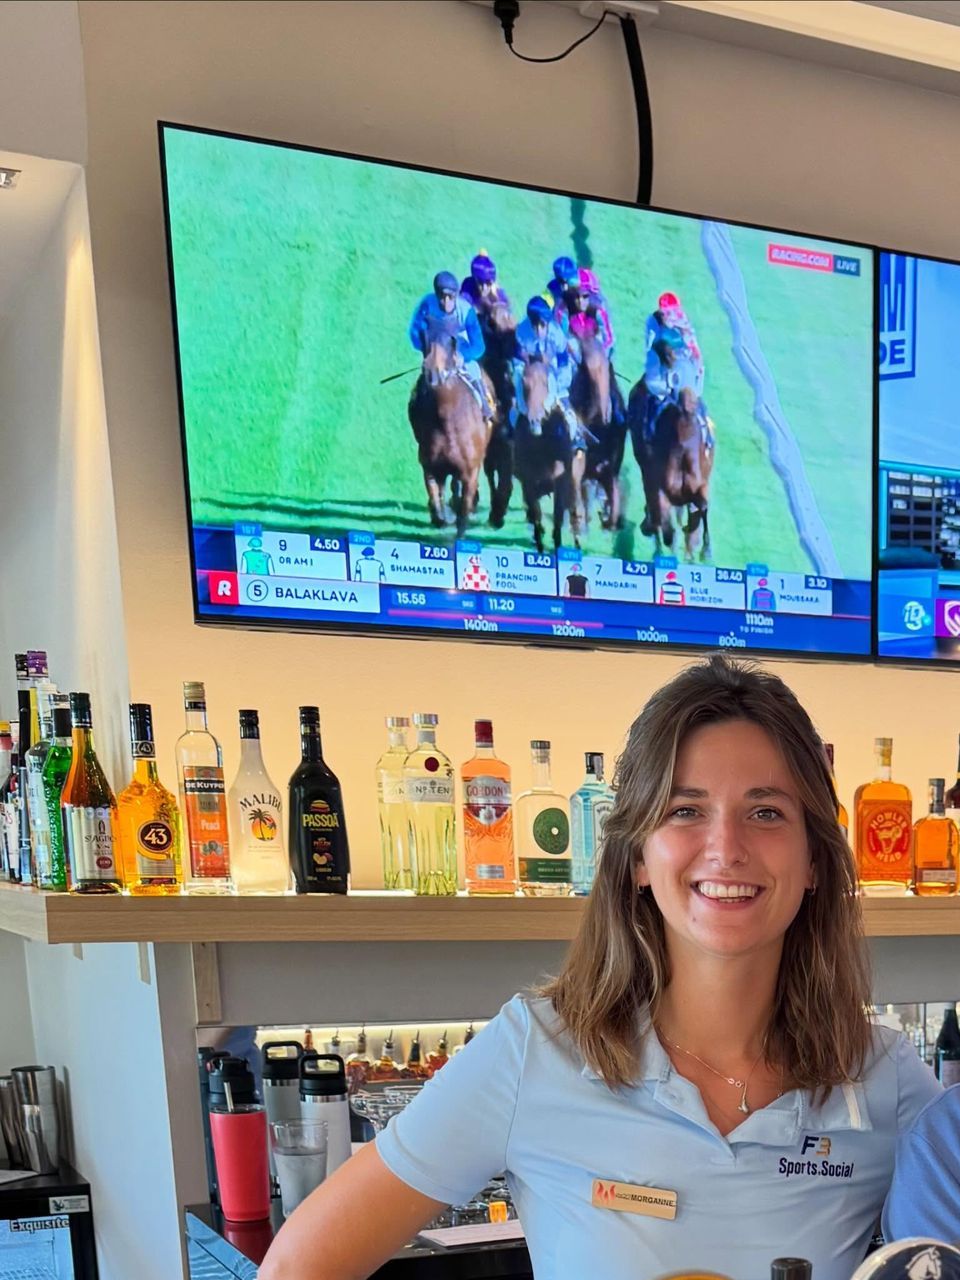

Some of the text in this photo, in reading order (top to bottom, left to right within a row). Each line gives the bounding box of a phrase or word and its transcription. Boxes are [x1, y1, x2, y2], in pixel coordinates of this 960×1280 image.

[836, 259, 858, 273] LIVE
[278, 539, 288, 552] 9
[390, 548, 400, 559] 4
[495, 556, 509, 568] 10
[390, 564, 446, 577] SHAMASTAR
[495, 571, 539, 583] PRANCING
[595, 564, 603, 576] 7
[690, 571, 702, 584] 13
[217, 581, 232, 597] R
[495, 580, 517, 590] FOOL
[275, 586, 359, 604] BALAKLAVA
[488, 598, 516, 612] 11.20
[463, 619, 499, 633] 1400m
[552, 624, 585, 638] 1200m
[636, 629, 669, 643] 1000m
[718, 635, 747, 648] 800m
[430, 785, 450, 795] TEN
[239, 793, 283, 813] MALIBU
[144, 828, 168, 845] 43
[800, 1135, 832, 1158] F3
[778, 1156, 855, 1179] Sports.Social
[630, 1193, 676, 1208] MORGANNE
[10, 1217, 70, 1234] Exquisite
